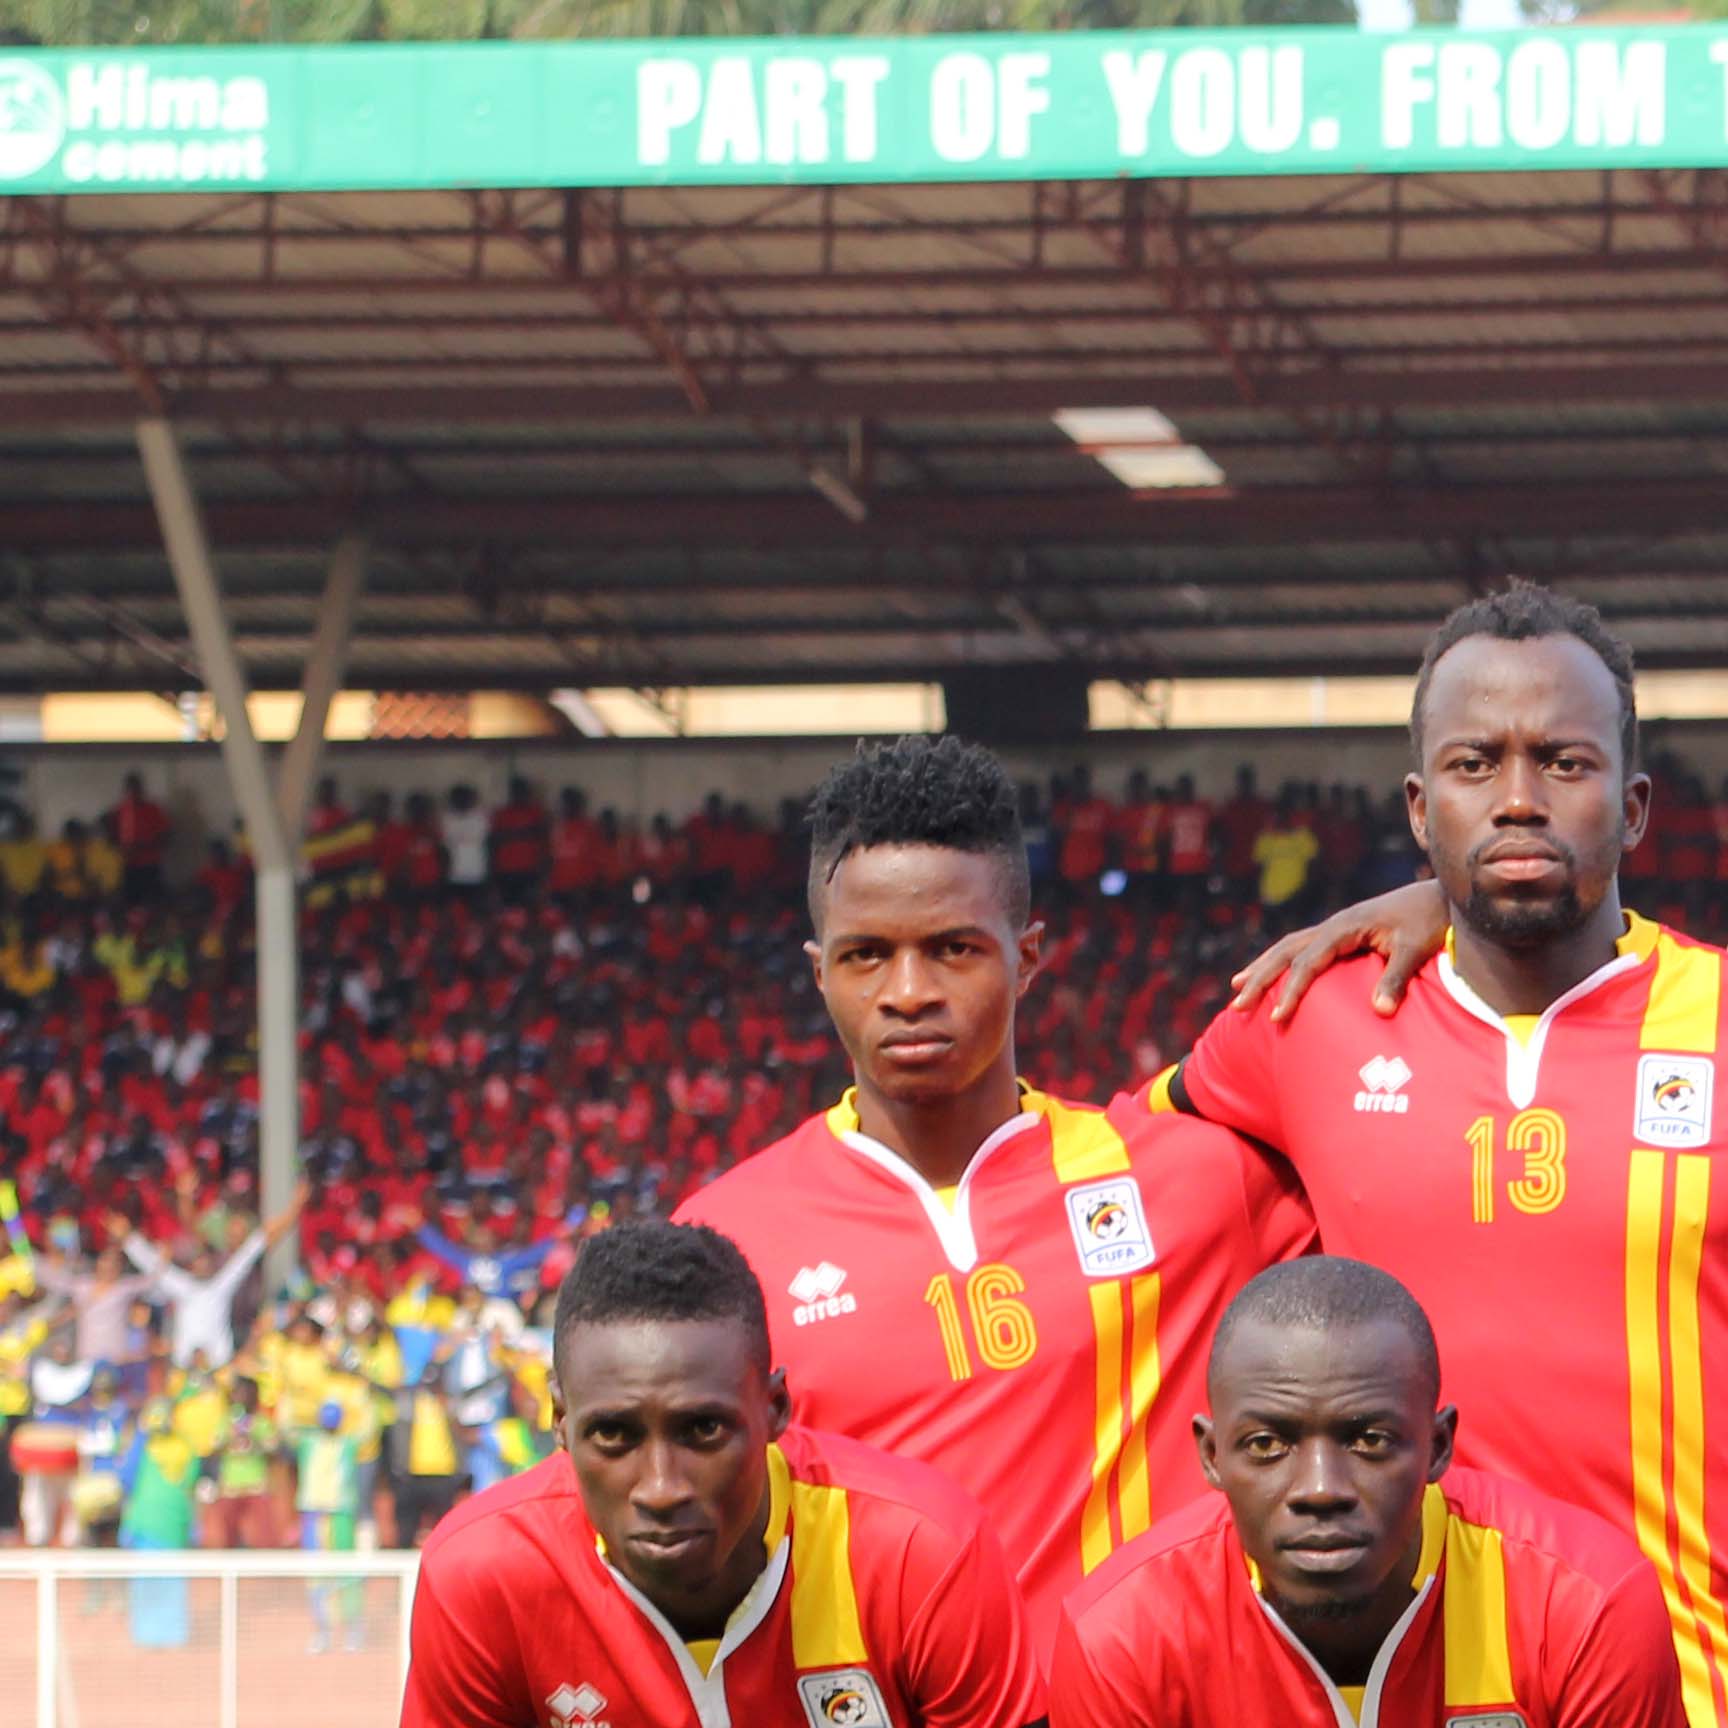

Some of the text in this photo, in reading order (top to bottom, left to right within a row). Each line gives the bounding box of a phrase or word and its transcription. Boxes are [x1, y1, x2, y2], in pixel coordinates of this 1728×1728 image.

[65, 63, 269, 131] Hima
[637, 56, 890, 165] PART
[930, 53, 1051, 162] OF
[1101, 45, 1341, 157] YOU.
[1380, 37, 1667, 149] FROM
[61, 134, 269, 182] cement
[1650, 1122, 1692, 1136] FUFA
[1464, 1107, 1566, 1223] 13
[1096, 1246, 1137, 1265] FUFA
[924, 1264, 1038, 1382] 16
